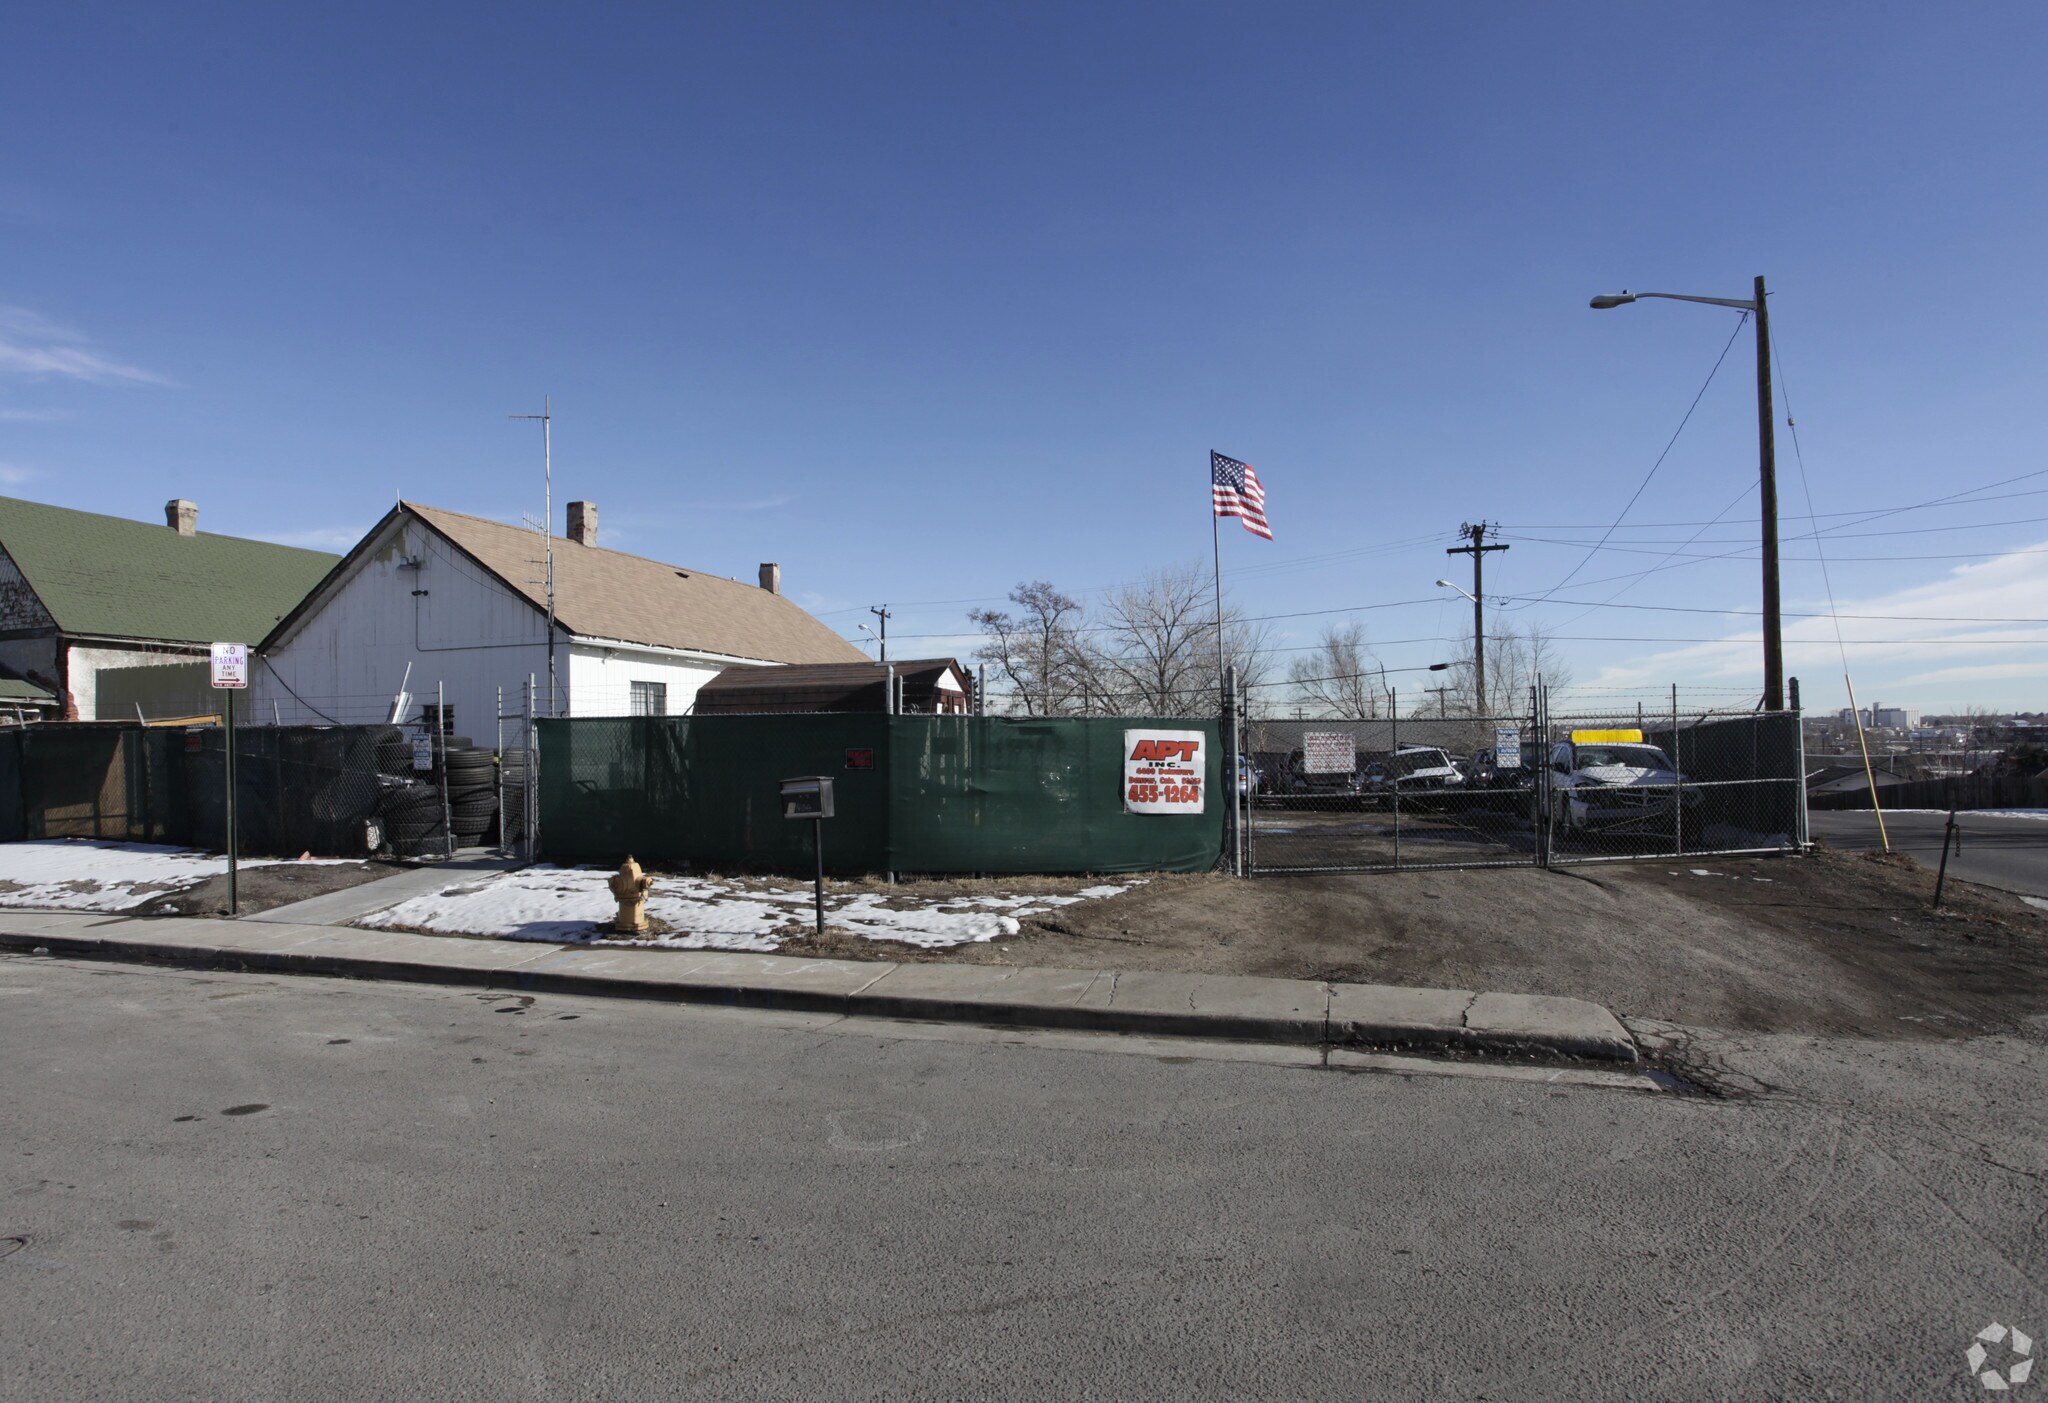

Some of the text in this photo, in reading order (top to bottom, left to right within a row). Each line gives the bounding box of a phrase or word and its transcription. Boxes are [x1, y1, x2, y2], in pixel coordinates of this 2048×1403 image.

[223, 646, 236, 655] NO
[215, 656, 244, 665] PARKING
[1130, 740, 1200, 762] APT
[1128, 785, 1199, 803] 455-1264
